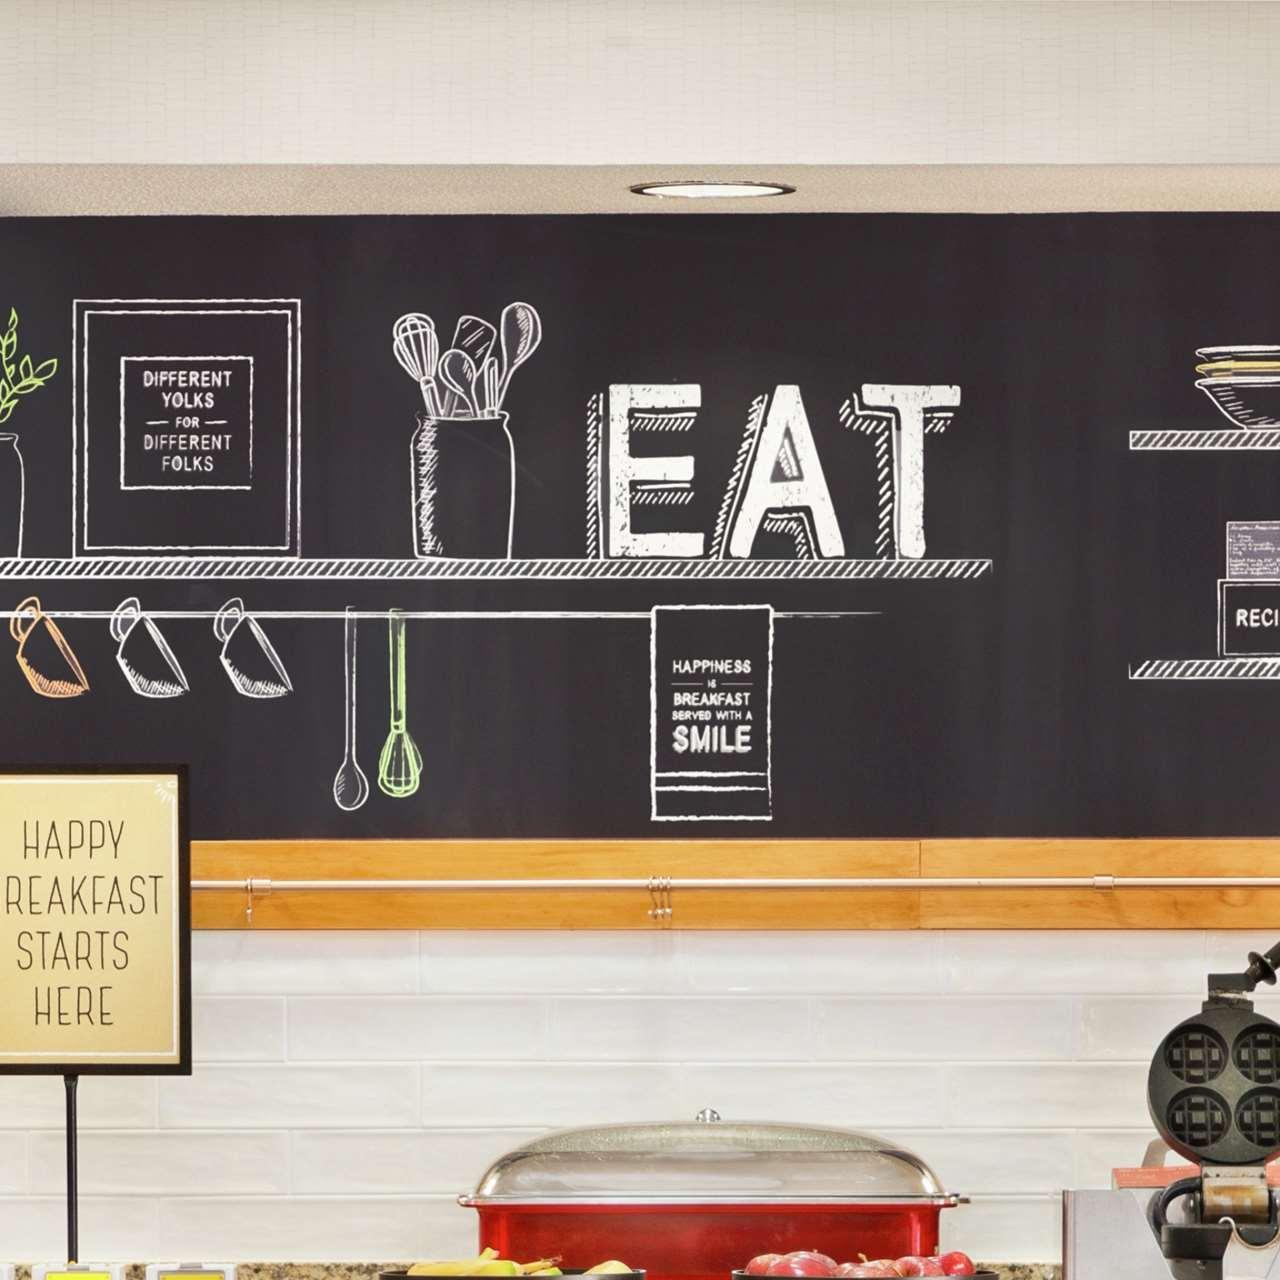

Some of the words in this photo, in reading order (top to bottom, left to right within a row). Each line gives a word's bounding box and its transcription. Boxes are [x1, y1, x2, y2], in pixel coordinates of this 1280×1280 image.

[143, 370, 232, 387] DIFFERENT
[162, 392, 215, 408] YOLKS
[175, 416, 200, 428] FOR
[143, 434, 232, 450] DIFFERENT
[162, 456, 214, 471] FOLKS
[587, 384, 962, 559] EAT
[672, 659, 752, 674] HAPPINESS
[707, 679, 717, 688] IS
[673, 692, 751, 706] BREAKFAST
[672, 710, 712, 720] SERVED
[715, 710, 741, 720] WITH
[745, 710, 753, 720] A
[672, 724, 752, 754] SMILE
[23, 820, 125, 860] HAPPY
[17, 931, 129, 970] STARTS
[34, 986, 114, 1025] HERE
